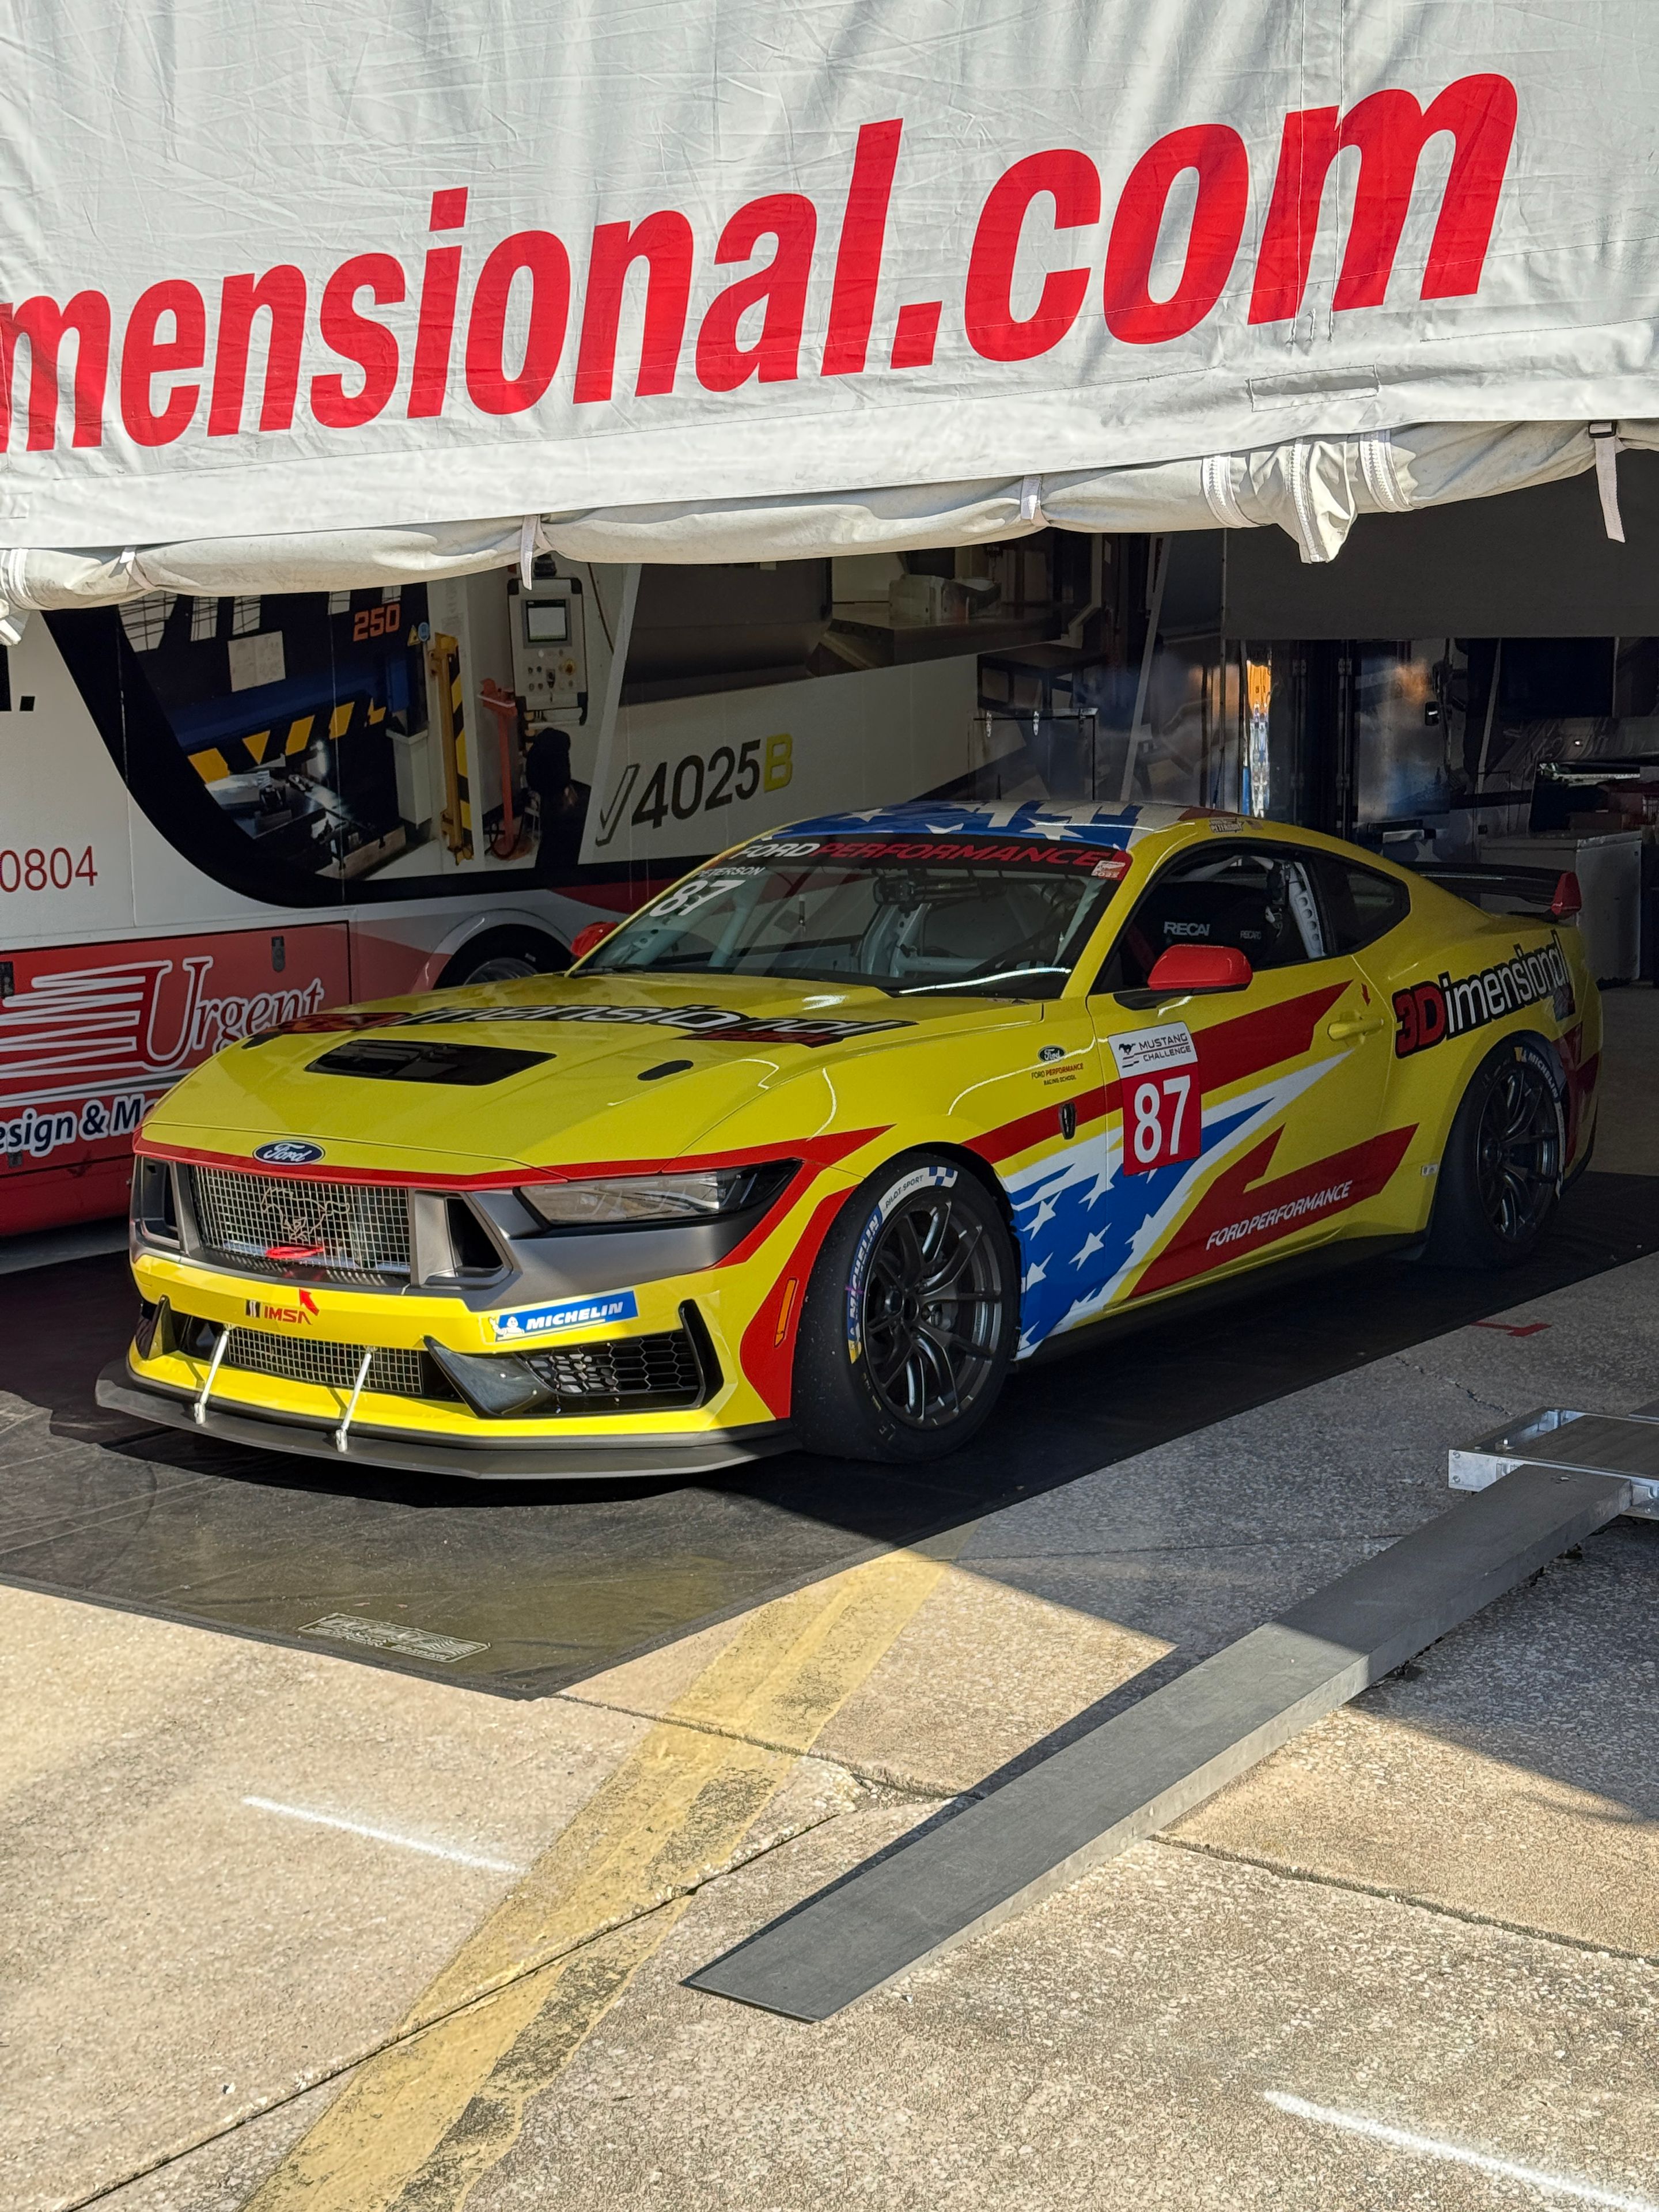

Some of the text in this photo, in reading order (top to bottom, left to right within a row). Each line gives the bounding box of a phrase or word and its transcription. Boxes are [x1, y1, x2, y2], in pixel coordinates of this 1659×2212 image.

[0, 73, 1517, 453] mensional.com
[353, 603, 400, 642] 250
[0, 846, 98, 892] 0804
[691, 866, 766, 878] PETERSON
[649, 880, 745, 917] 87
[1393, 930, 1571, 1058] 3Dimensional
[147, 956, 324, 1072] Urgent
[1044, 1048, 1060, 1060] Ford
[1139, 1032, 1188, 1051] MUSTANG
[1143, 1045, 1192, 1062] CHALLENGE
[1031, 1063, 1084, 1080] FORD PERFORMANCE
[1527, 1052, 1559, 1099] MICHELIN
[82, 1104, 106, 1135] &
[1134, 1074, 1191, 1164] 87
[263, 1142, 313, 1162] Ford
[885, 1174, 924, 1209] PILOT SPORT
[849, 1214, 880, 1320] MICHELIN
[264, 1305, 313, 1325] IMSA
[525, 1301, 624, 1331] MICHELIN
